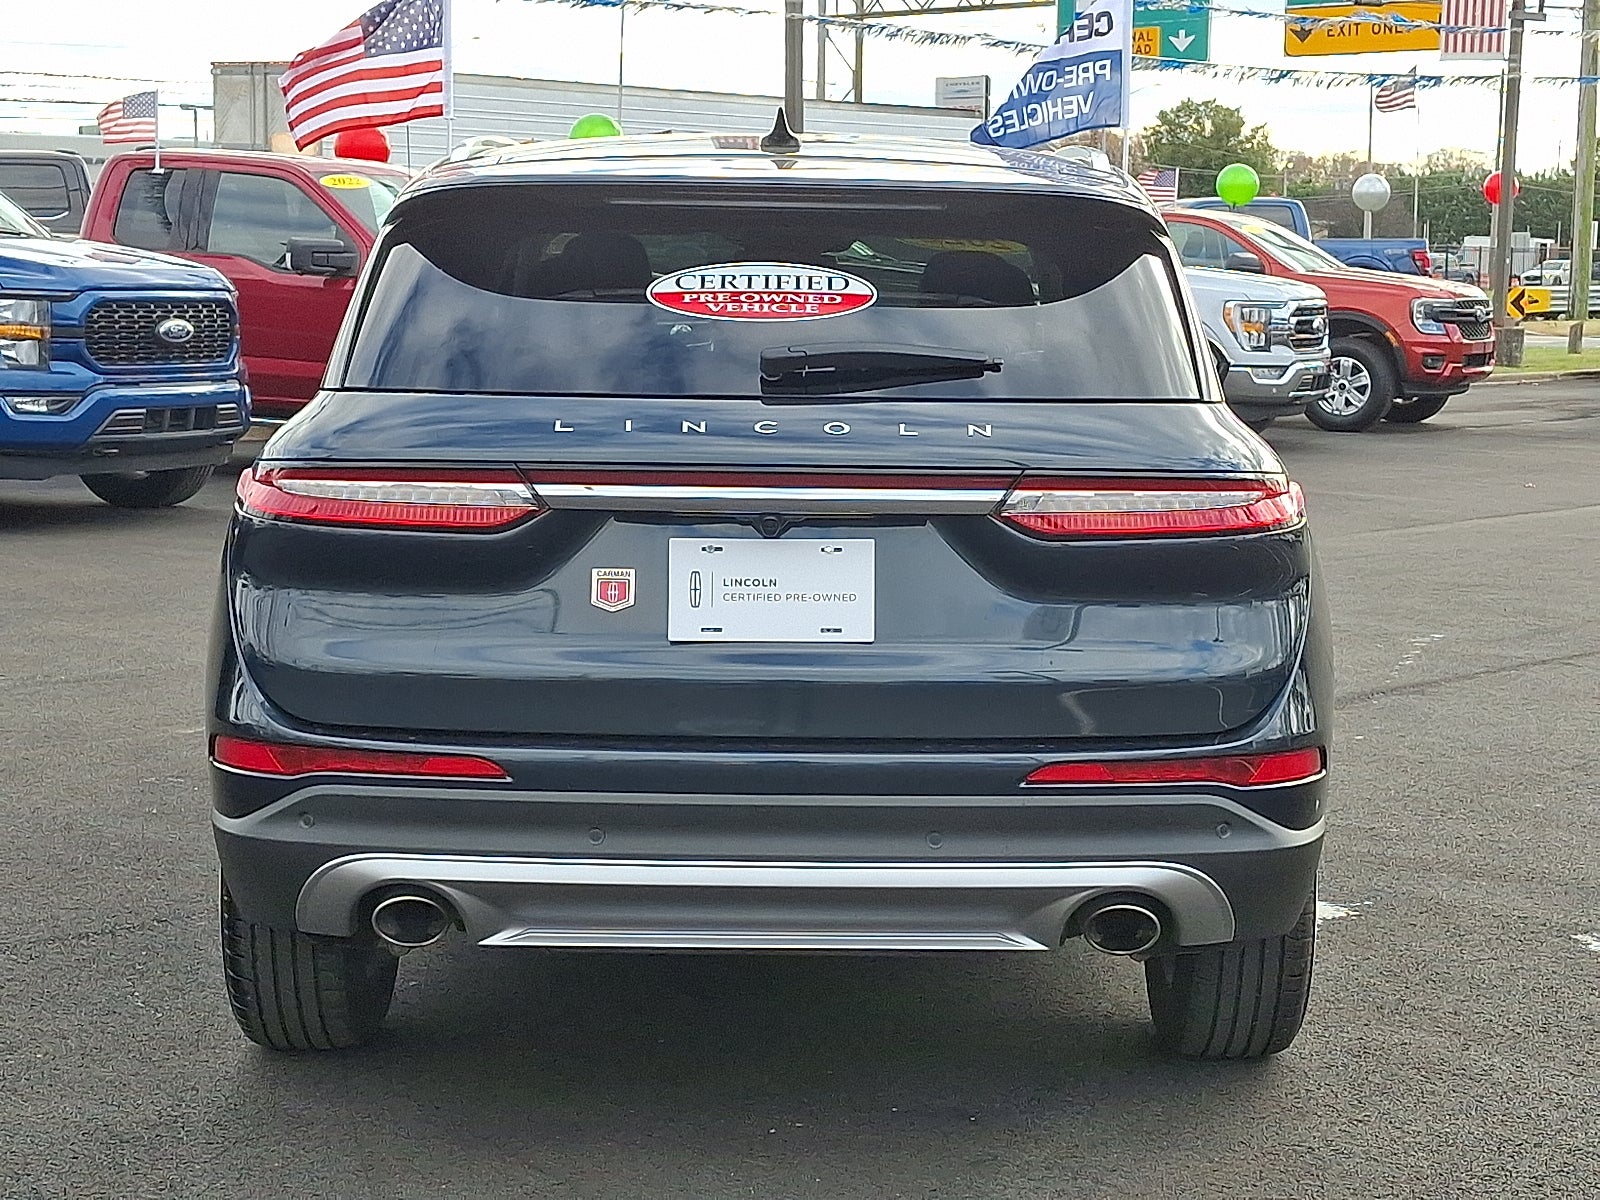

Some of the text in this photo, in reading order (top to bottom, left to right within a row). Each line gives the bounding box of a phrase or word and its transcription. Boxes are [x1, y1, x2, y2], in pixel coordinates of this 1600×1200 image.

[1327, 22, 1409, 37] EXIT ONL
[674, 274, 850, 292] CERTIFIED
[681, 293, 842, 304] PRE-OWNED
[704, 303, 820, 314] VEHICLE
[553, 419, 993, 438] LINCOLN
[722, 578, 778, 588] LINCOLN
[722, 592, 858, 602] CERTIFIED PRE-OWNED
